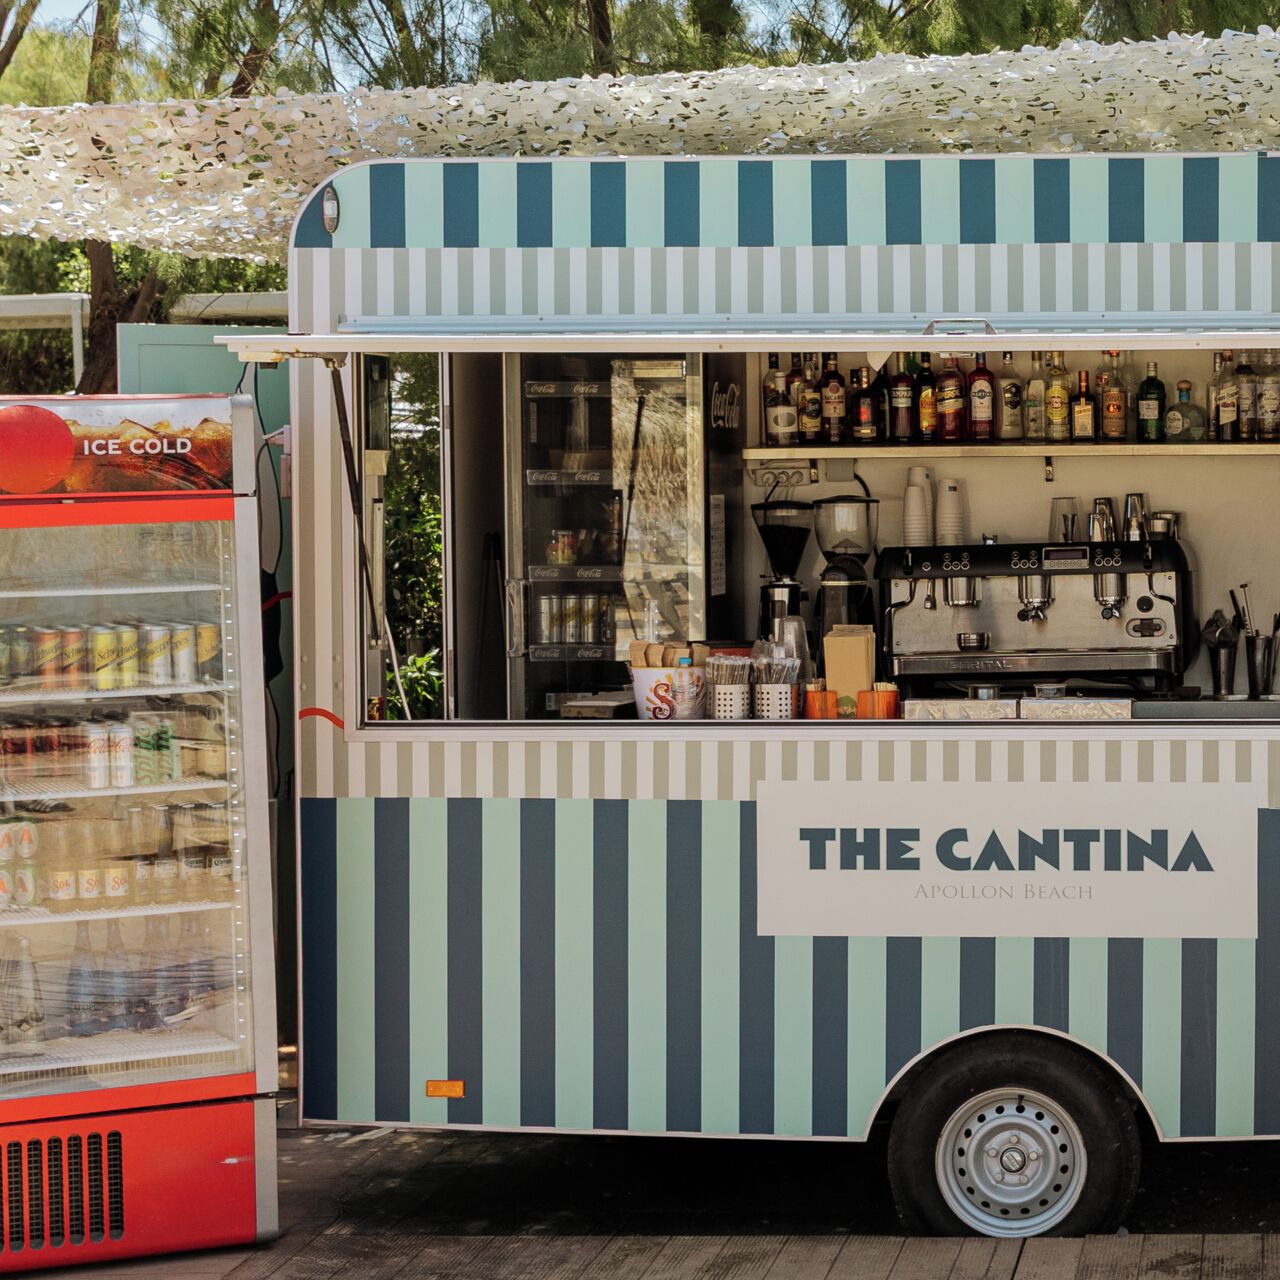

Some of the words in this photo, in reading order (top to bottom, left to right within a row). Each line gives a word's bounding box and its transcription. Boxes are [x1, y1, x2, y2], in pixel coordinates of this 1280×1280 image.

[83, 439, 122, 455] ICE
[129, 438, 192, 454] COLD
[799, 827, 921, 871] THE
[935, 827, 1215, 872] CANTINA
[914, 883, 1014, 900] APOLLON
[1024, 883, 1093, 900] BEACH
